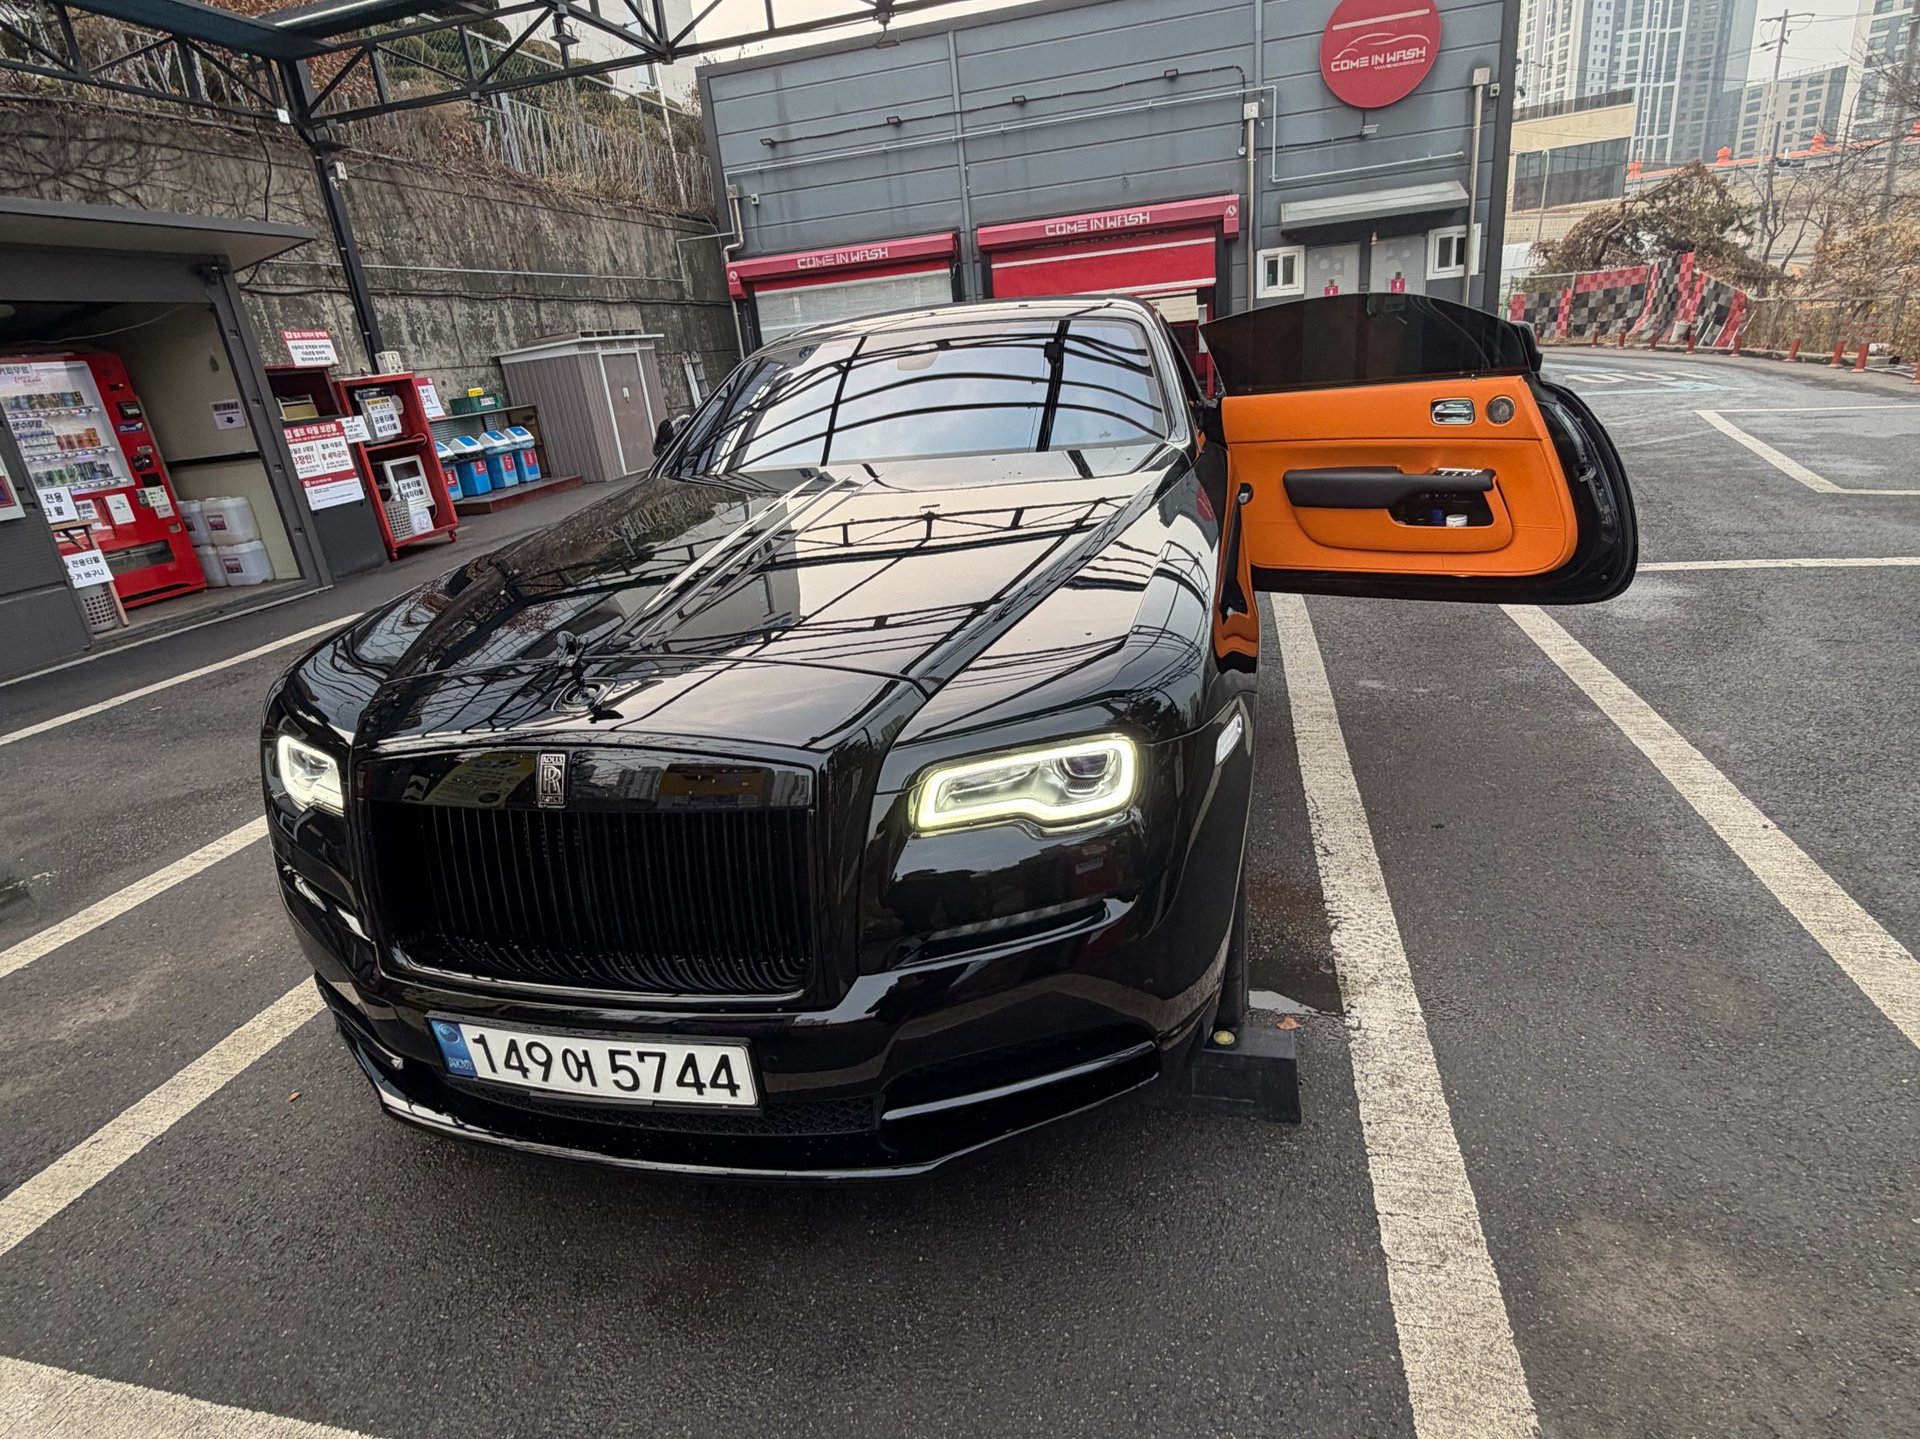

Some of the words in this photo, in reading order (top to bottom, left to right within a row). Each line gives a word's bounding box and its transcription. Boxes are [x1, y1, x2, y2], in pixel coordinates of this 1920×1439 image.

[1330, 56, 1370, 72] COME
[1371, 53, 1385, 66] IN
[1386, 46, 1427, 62] WASH
[1045, 219, 1088, 236] COME
[1090, 218, 1104, 231] IN
[1106, 211, 1150, 229] WASH
[797, 254, 835, 270] COME
[836, 252, 848, 264] IN
[850, 247, 889, 262] WASH
[44, 492, 64, 504] 전용
[83, 568, 105, 579] 바구니
[542, 756, 563, 764] ROLLS
[607, 1048, 741, 1098] 5744
